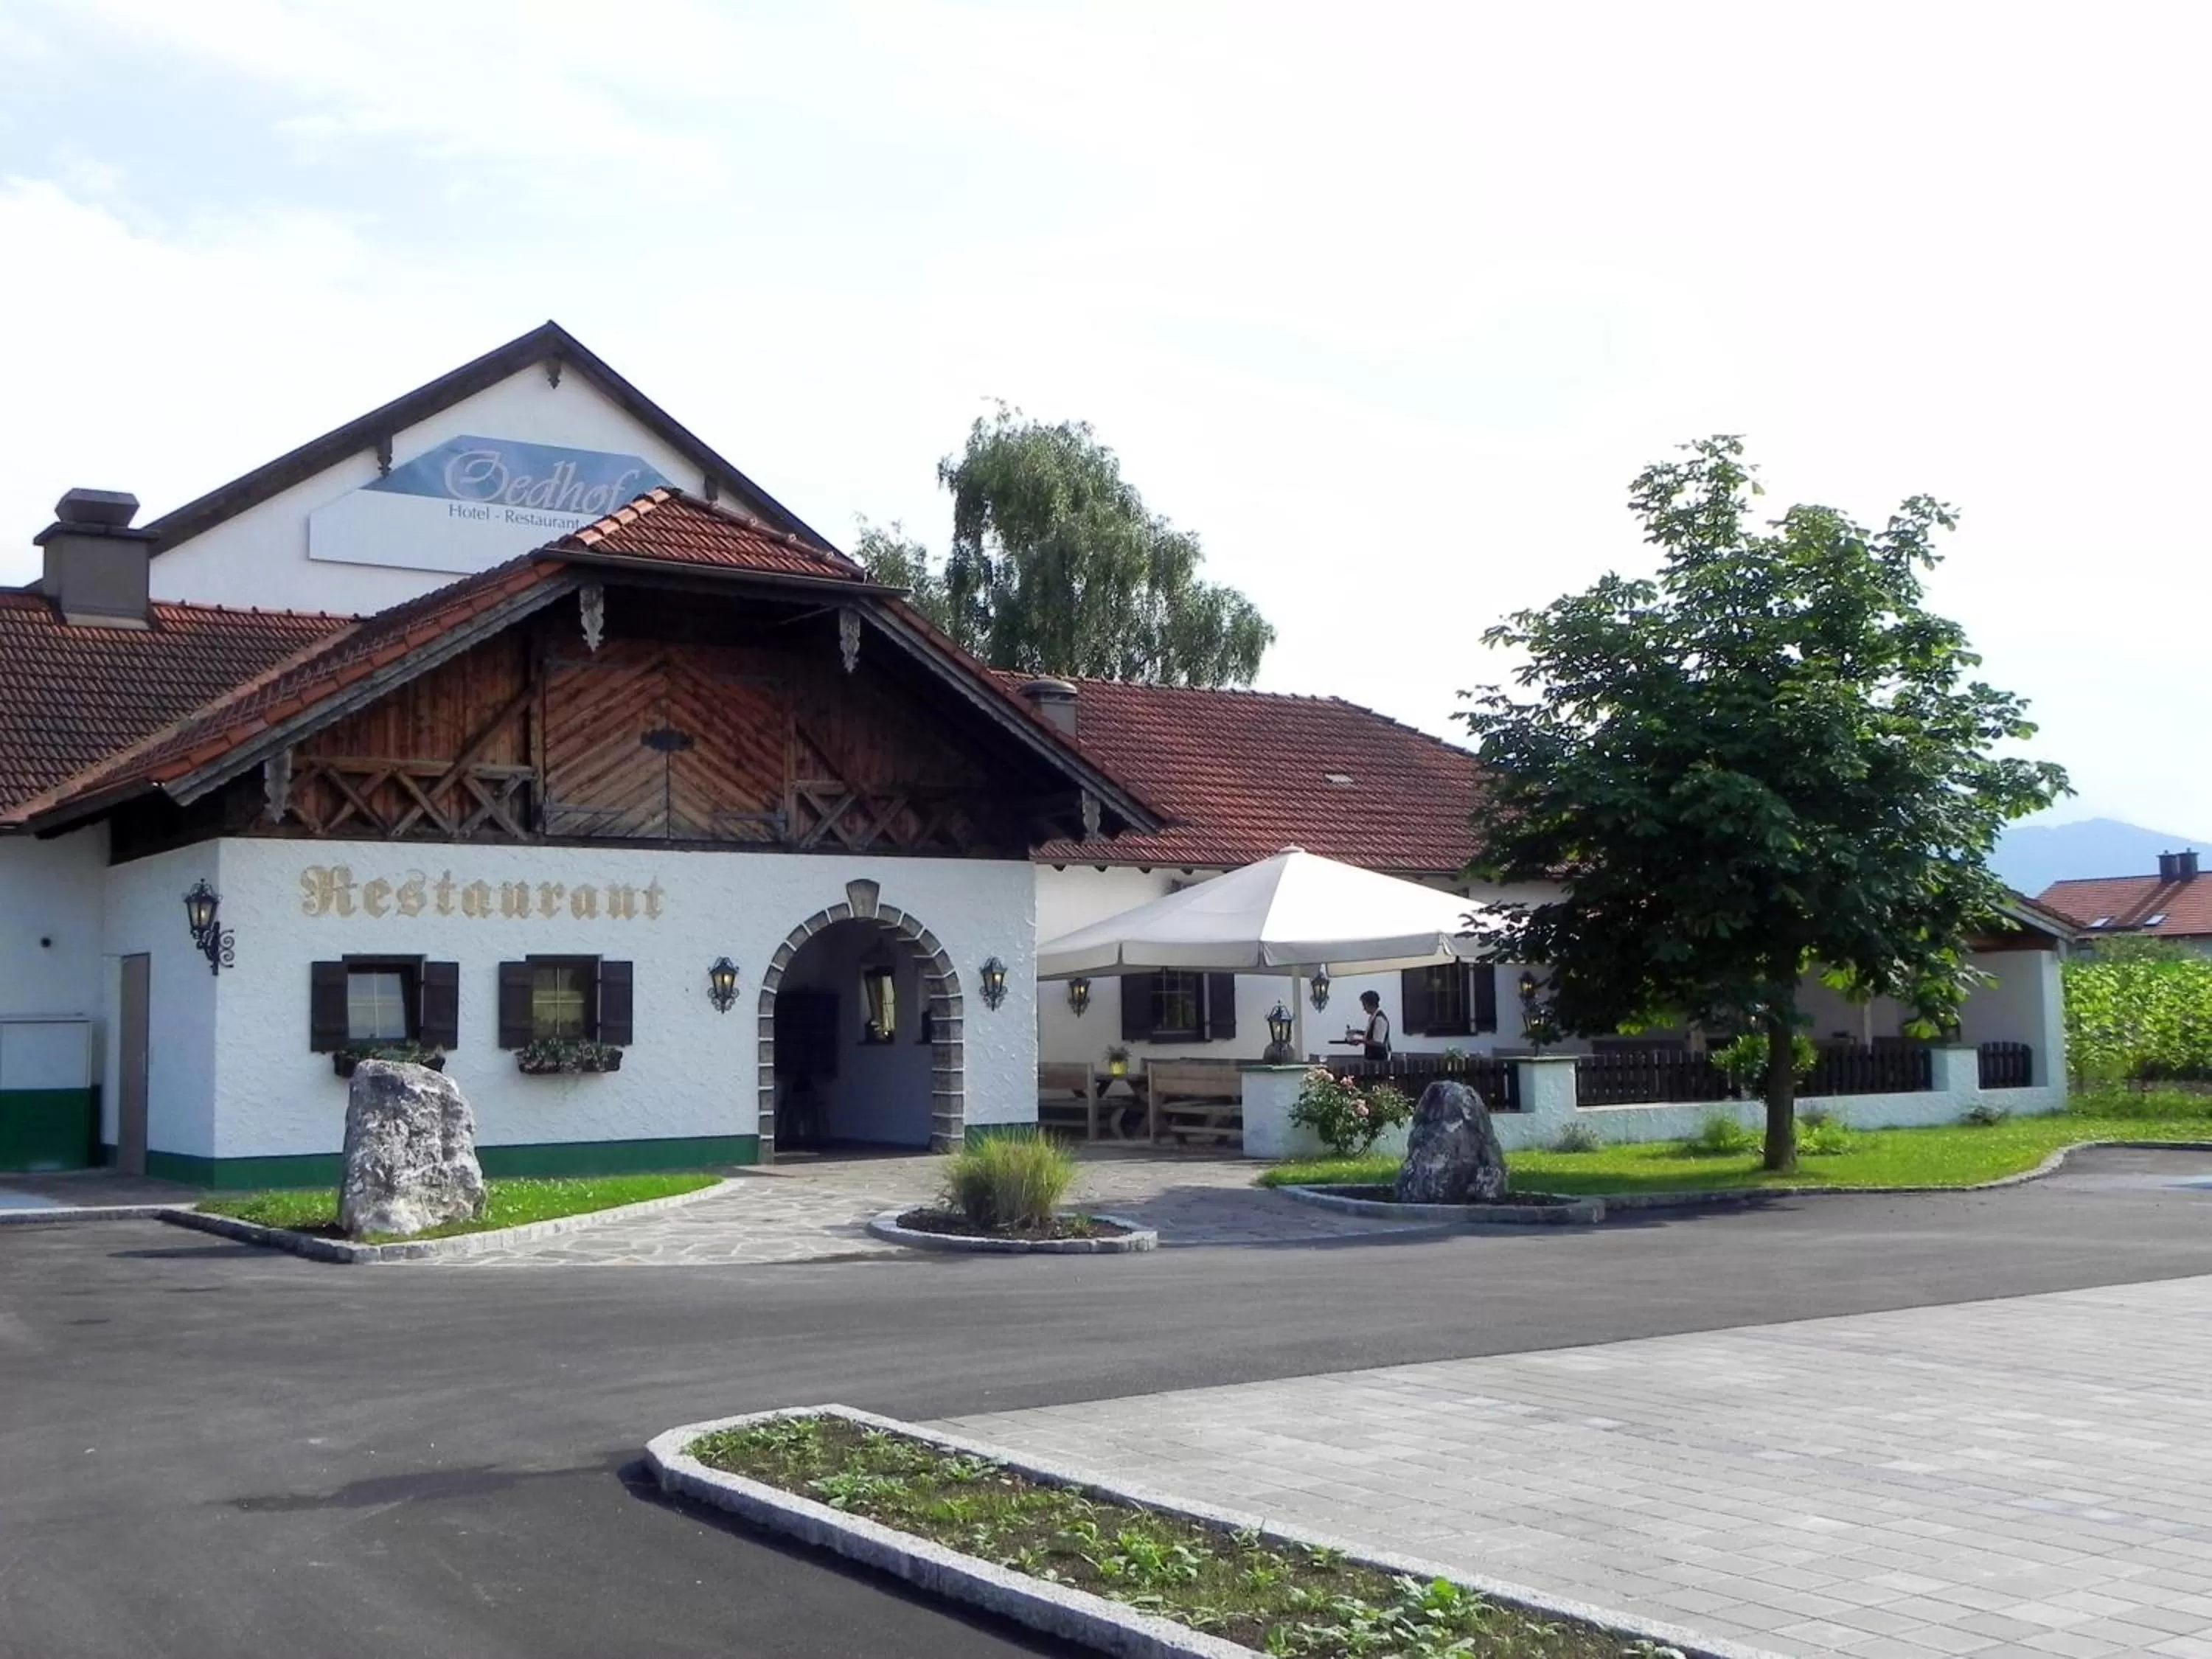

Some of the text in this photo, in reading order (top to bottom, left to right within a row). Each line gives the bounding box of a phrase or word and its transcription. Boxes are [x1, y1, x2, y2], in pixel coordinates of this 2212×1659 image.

[444, 450, 640, 515] Oedhof
[448, 503, 490, 521] Hotel
[504, 509, 580, 530] Restaurant
[299, 864, 664, 920] Restaurant
